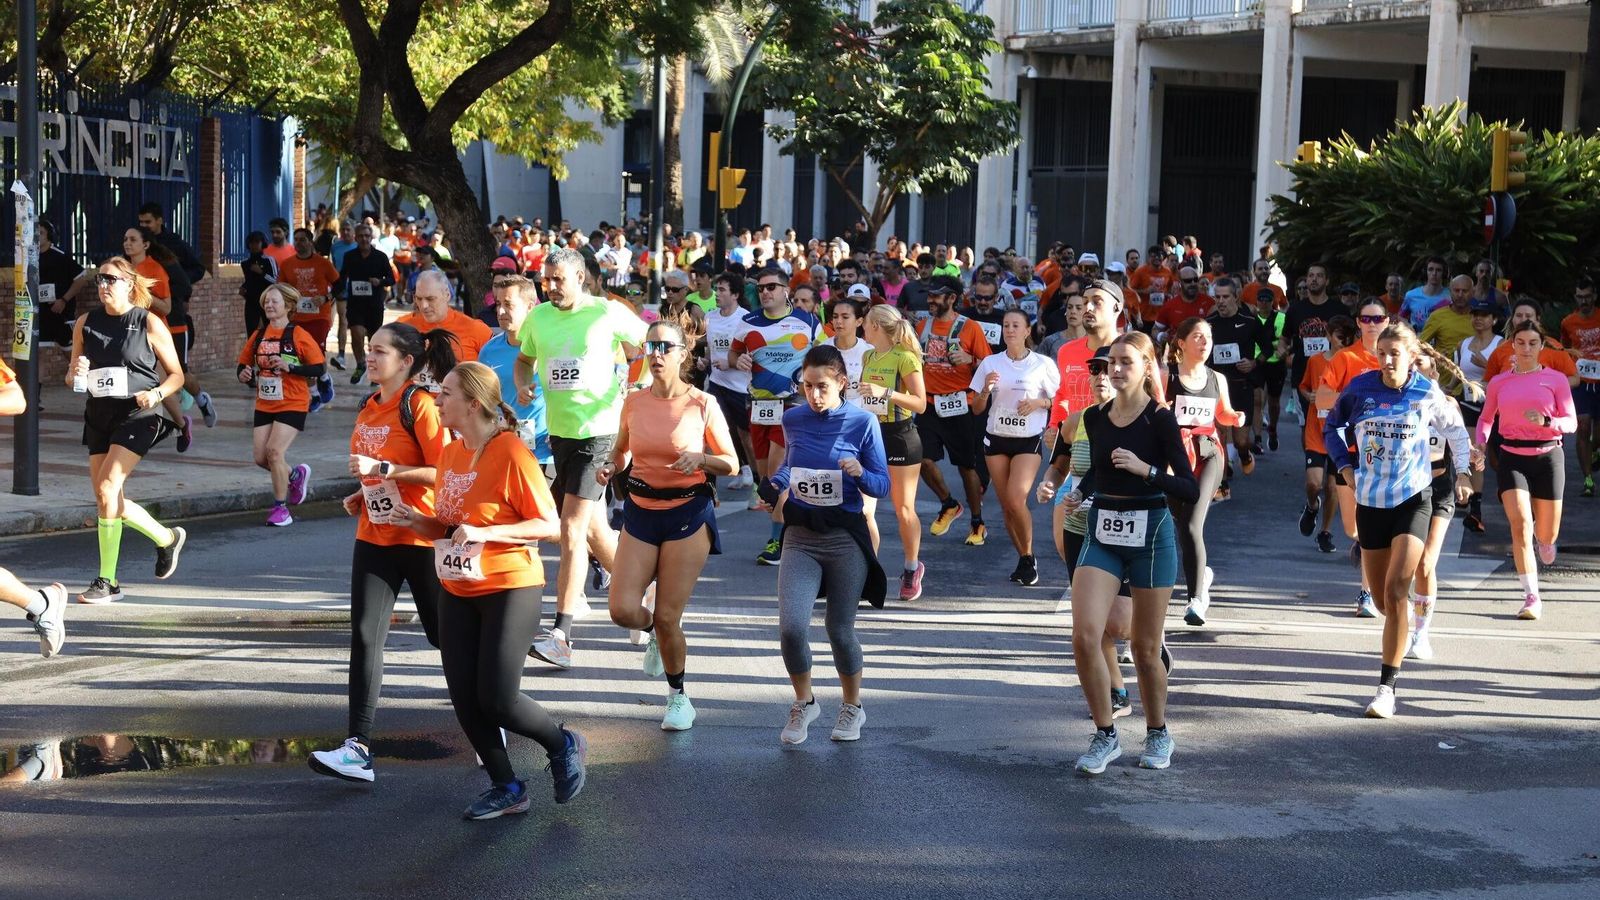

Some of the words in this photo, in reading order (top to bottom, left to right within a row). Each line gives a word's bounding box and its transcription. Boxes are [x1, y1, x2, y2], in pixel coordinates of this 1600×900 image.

[714, 339, 730, 347] 128
[1307, 343, 1324, 351] 557
[552, 368, 580, 380] 522
[97, 377, 114, 388] 54
[863, 396, 886, 405] 1024
[940, 400, 962, 411] 583
[759, 409, 774, 418] 68
[1180, 406, 1211, 417] 1075
[998, 417, 1026, 427] 1066
[797, 481, 833, 495] 618
[1102, 518, 1135, 534] 891
[442, 554, 472, 572] 444
